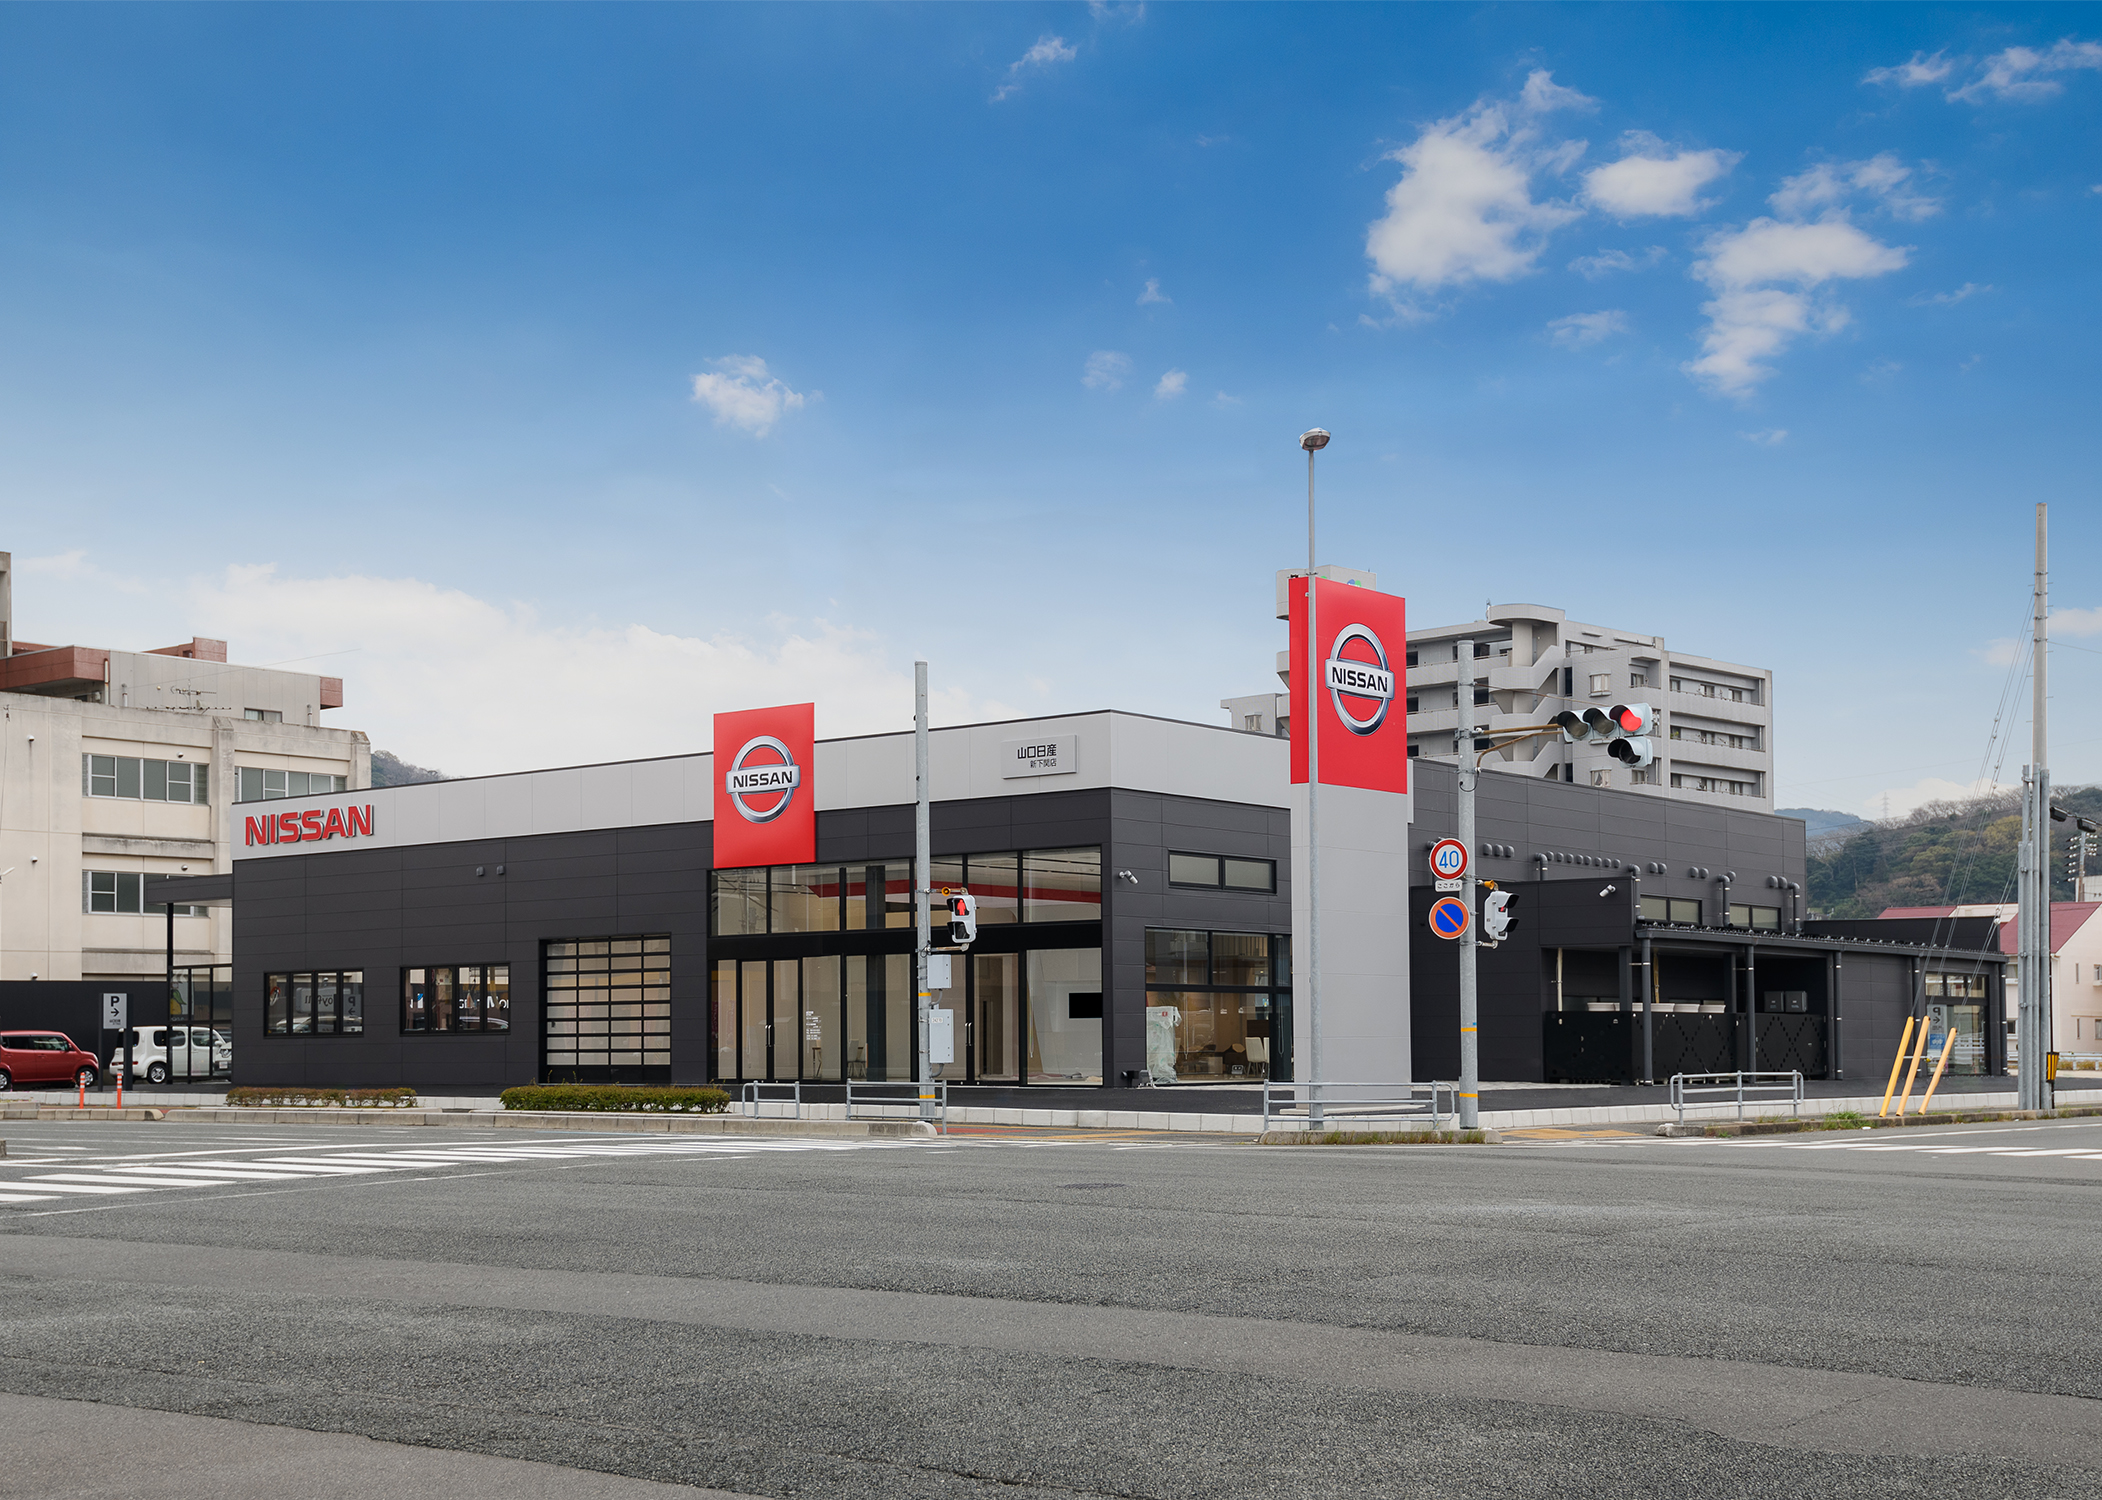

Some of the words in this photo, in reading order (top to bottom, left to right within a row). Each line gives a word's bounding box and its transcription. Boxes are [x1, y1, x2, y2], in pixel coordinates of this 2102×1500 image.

[1332, 666, 1388, 693] NISSAN
[1017, 743, 1057, 760] 山口日産
[733, 770, 793, 789] NISSAN
[245, 804, 374, 846] NISSAN
[1439, 850, 1459, 868] 40
[110, 996, 120, 1007] P
